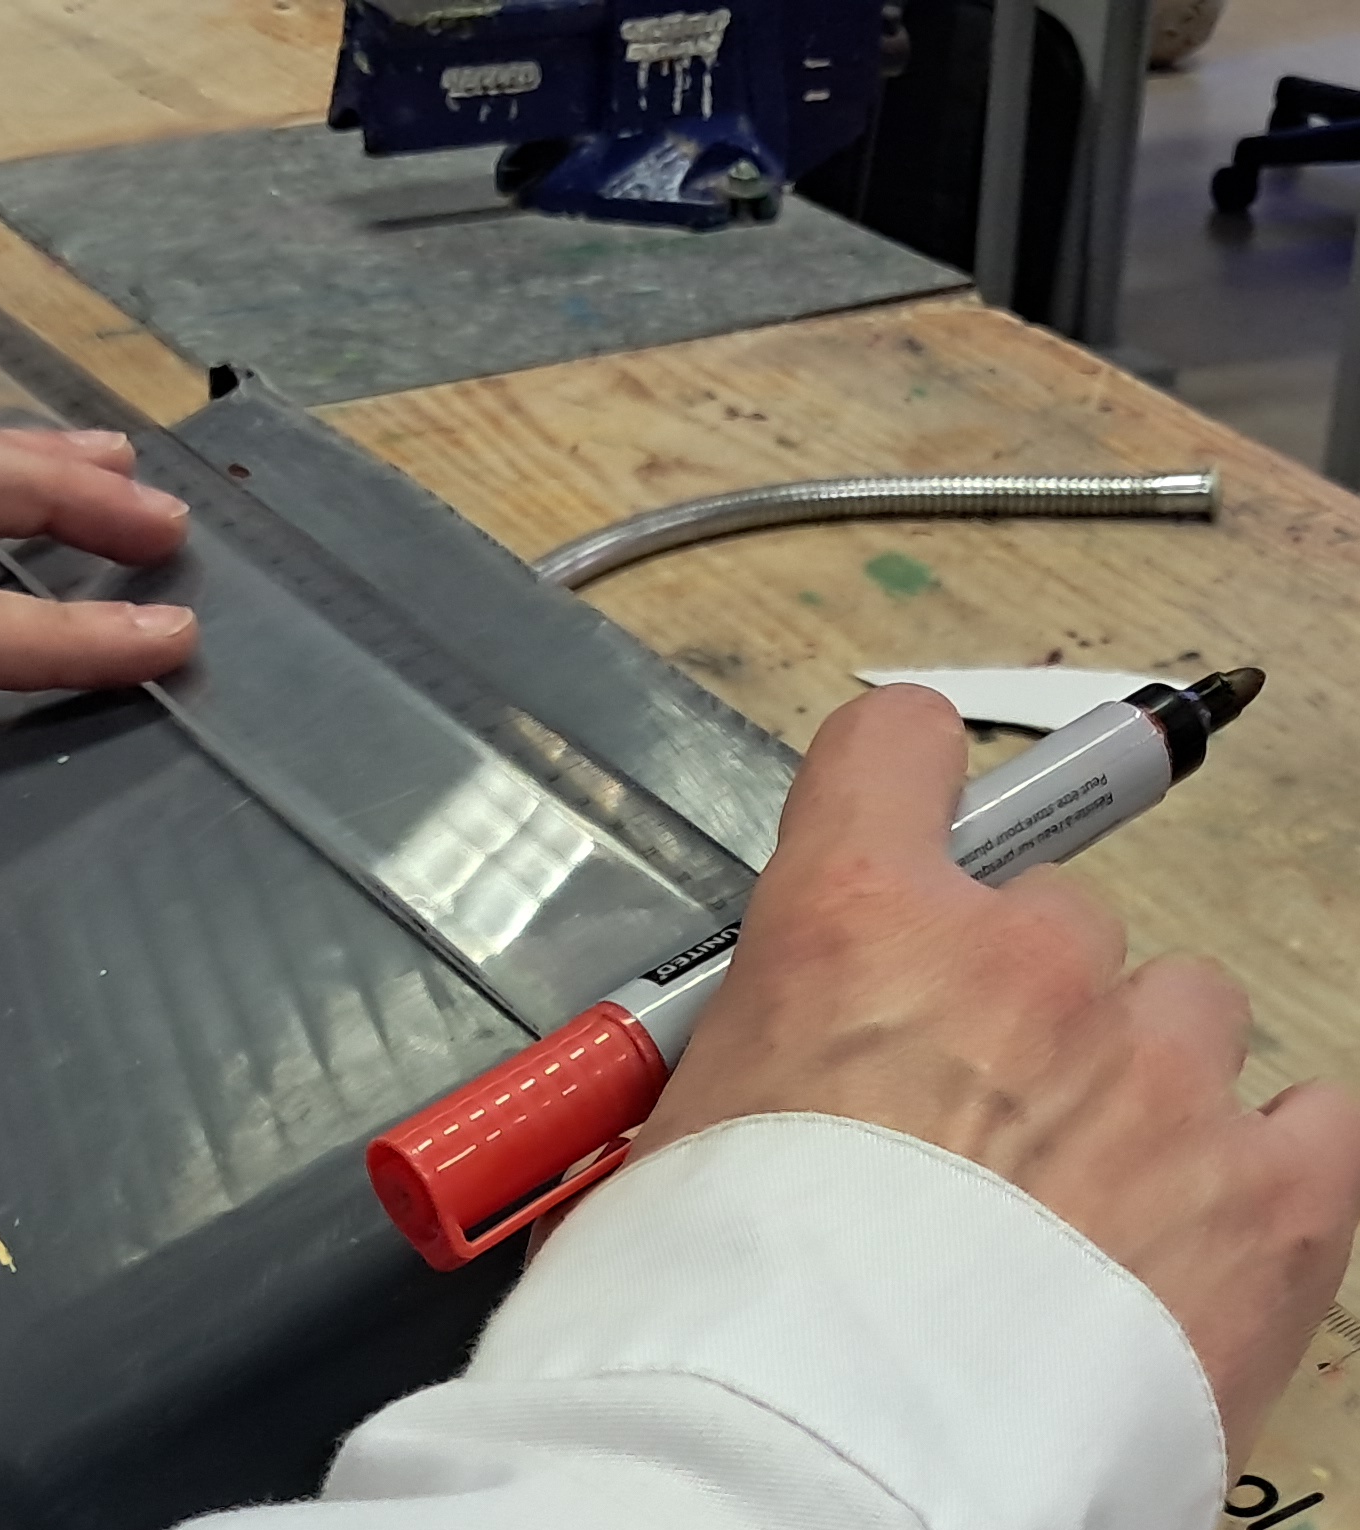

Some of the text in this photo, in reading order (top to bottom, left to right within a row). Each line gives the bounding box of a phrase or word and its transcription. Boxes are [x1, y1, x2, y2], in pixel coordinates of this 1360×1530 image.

[1080, 773, 1108, 795] Peut
[996, 821, 1025, 846] pour
[955, 840, 994, 868] plusie
[656, 928, 739, 977] UNITED
